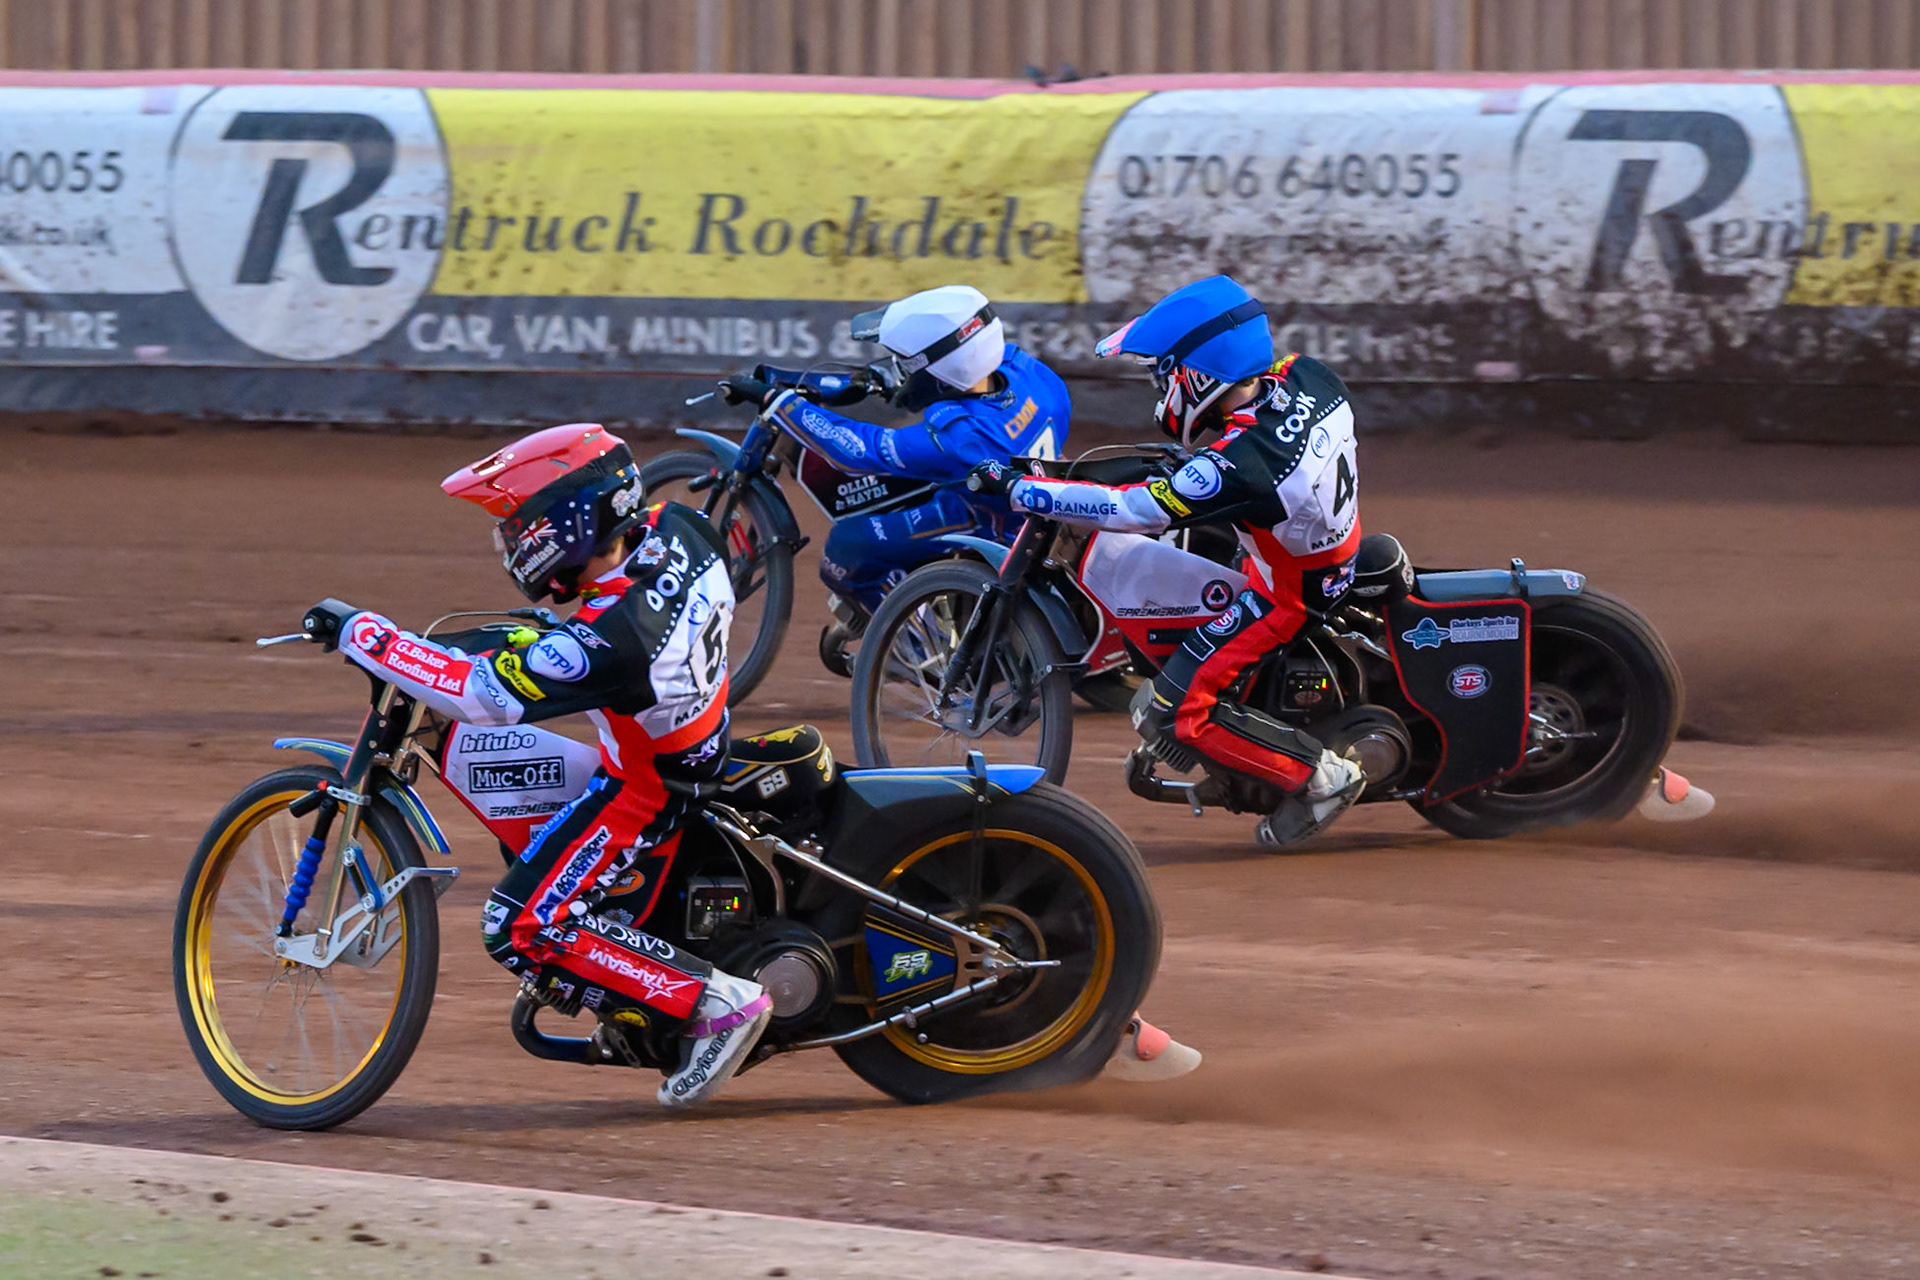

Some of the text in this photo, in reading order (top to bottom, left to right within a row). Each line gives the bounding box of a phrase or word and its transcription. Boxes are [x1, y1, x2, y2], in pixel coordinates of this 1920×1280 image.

[0, 150, 125, 193] 0055
[1117, 153, 1462, 199] 01706 640055
[688, 191, 1056, 261] Rochdale
[628, 316, 820, 358] MINIBUS
[1275, 391, 1317, 443] COOK
[837, 475, 878, 496] OLLIE
[1183, 465, 1210, 490] ATPI
[1333, 452, 1355, 518] 4
[1124, 605, 1200, 617] PREMIERSHIP
[541, 643, 575, 675] ATPI
[702, 610, 722, 685] 5
[387, 651, 438, 688] Roofing
[436, 673, 462, 693] Ltd
[1455, 675, 1483, 686] STS
[459, 731, 537, 754] bitubo
[474, 763, 560, 788] Muc-Off
[758, 769, 788, 796] 69
[556, 828, 608, 893] ACCESSORY
